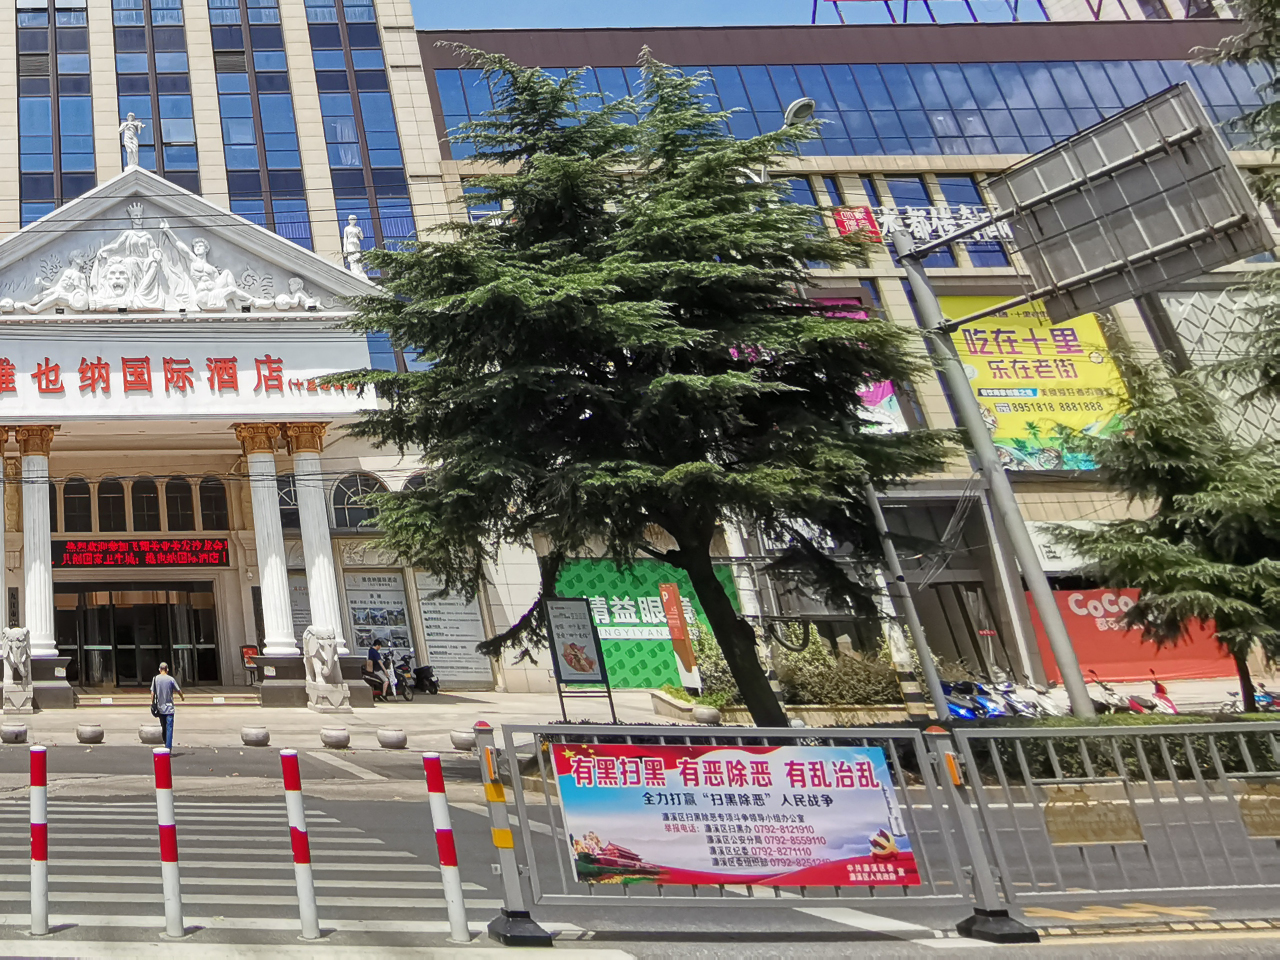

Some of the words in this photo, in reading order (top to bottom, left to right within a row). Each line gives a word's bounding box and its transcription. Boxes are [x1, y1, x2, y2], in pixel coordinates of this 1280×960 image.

[962, 328, 1084, 355] 吃在十里
[987, 359, 1078, 379] 乐在老街
[1012, 402, 1055, 412] 8951818
[1060, 402, 1104, 412] 8881888
[662, 592, 669, 602] P
[1068, 592, 1135, 618] CoCo
[572, 757, 667, 788] 有黑扫黑
[678, 758, 772, 788] 有恶除恶
[784, 760, 880, 790] 有乱治乱
[642, 792, 696, 806] 全力打赢
[781, 794, 834, 808] 人民战争
[754, 825, 814, 834] 0792-8121910
[764, 836, 826, 845] 0792-8559110
